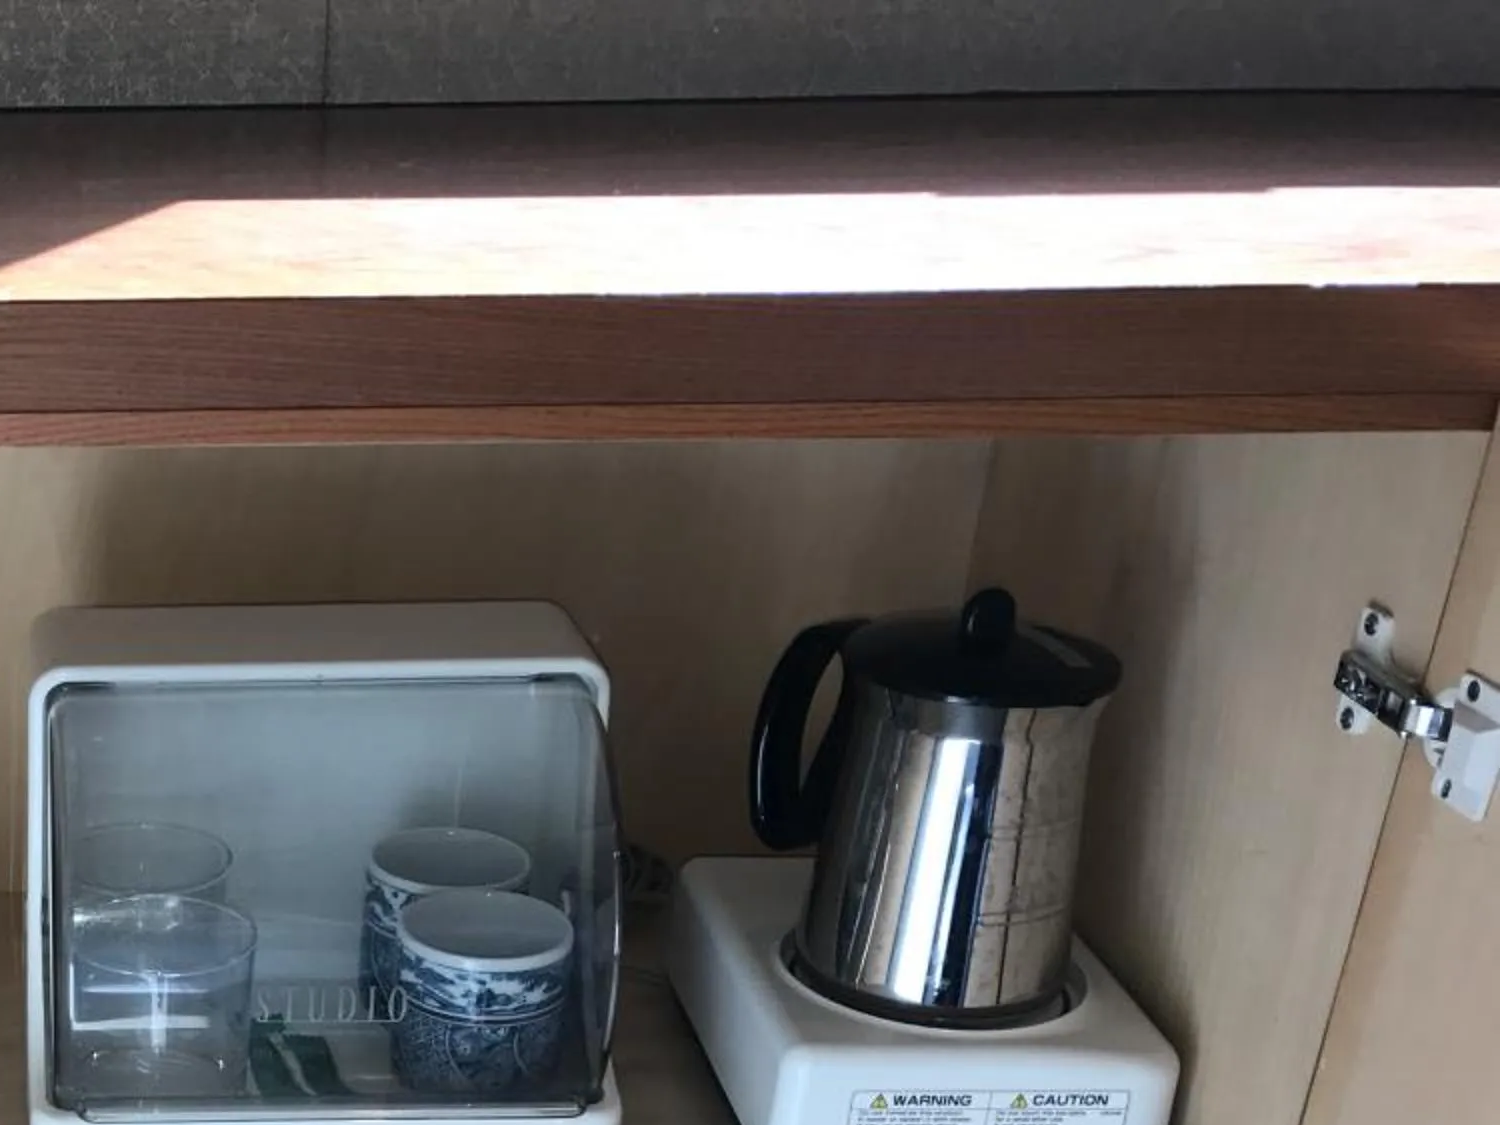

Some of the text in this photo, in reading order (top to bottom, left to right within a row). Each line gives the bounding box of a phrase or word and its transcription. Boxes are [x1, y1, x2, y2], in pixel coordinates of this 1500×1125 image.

[256, 985, 407, 1023] STUDIO
[893, 1094, 973, 1107] WARNING
[1033, 1094, 1109, 1106] CAUTION
